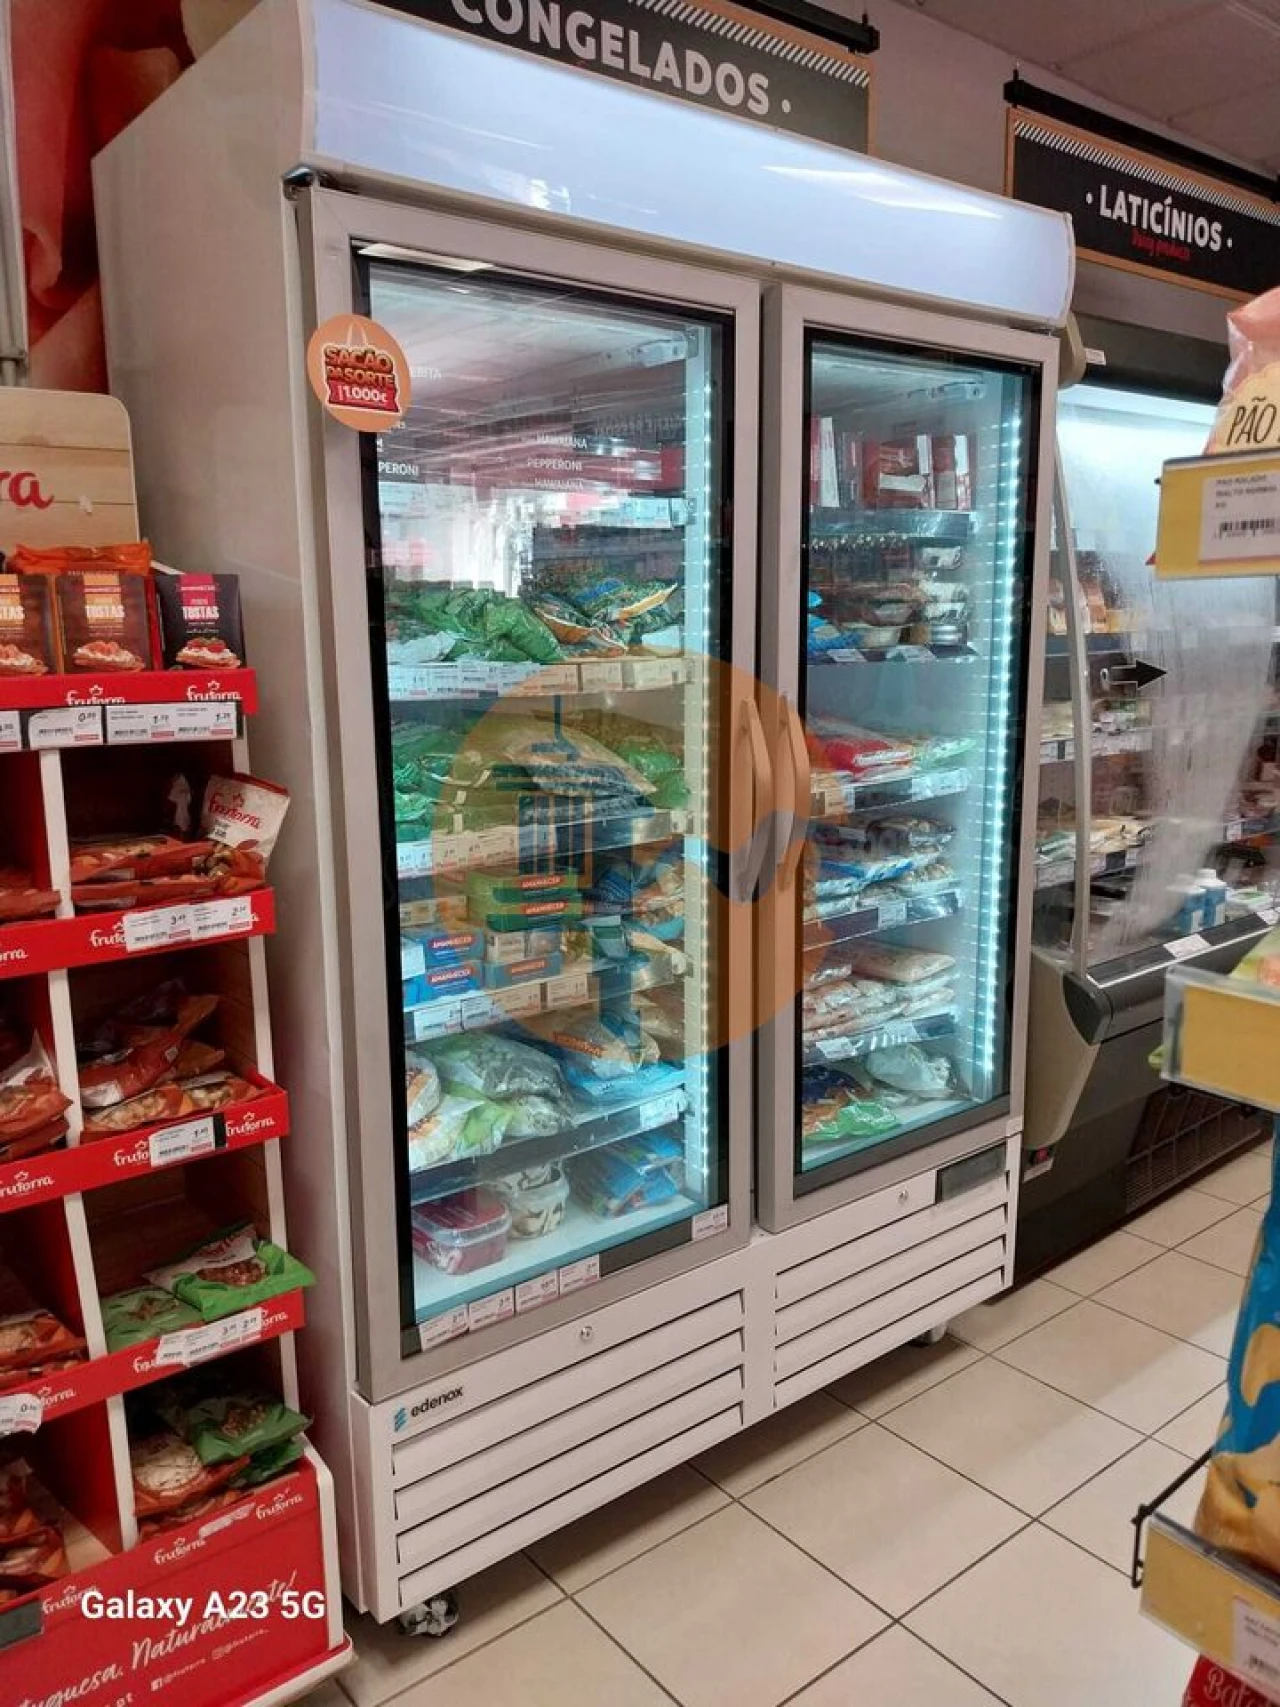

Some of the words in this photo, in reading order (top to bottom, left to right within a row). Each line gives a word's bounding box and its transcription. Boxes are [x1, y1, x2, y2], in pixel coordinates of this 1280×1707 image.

[1100, 184, 1222, 251] LATICÍNIOS
[1226, 396, 1277, 446] PÃO
[0, 1173, 54, 1199] rutorra
[411, 1386, 463, 1418] edenox
